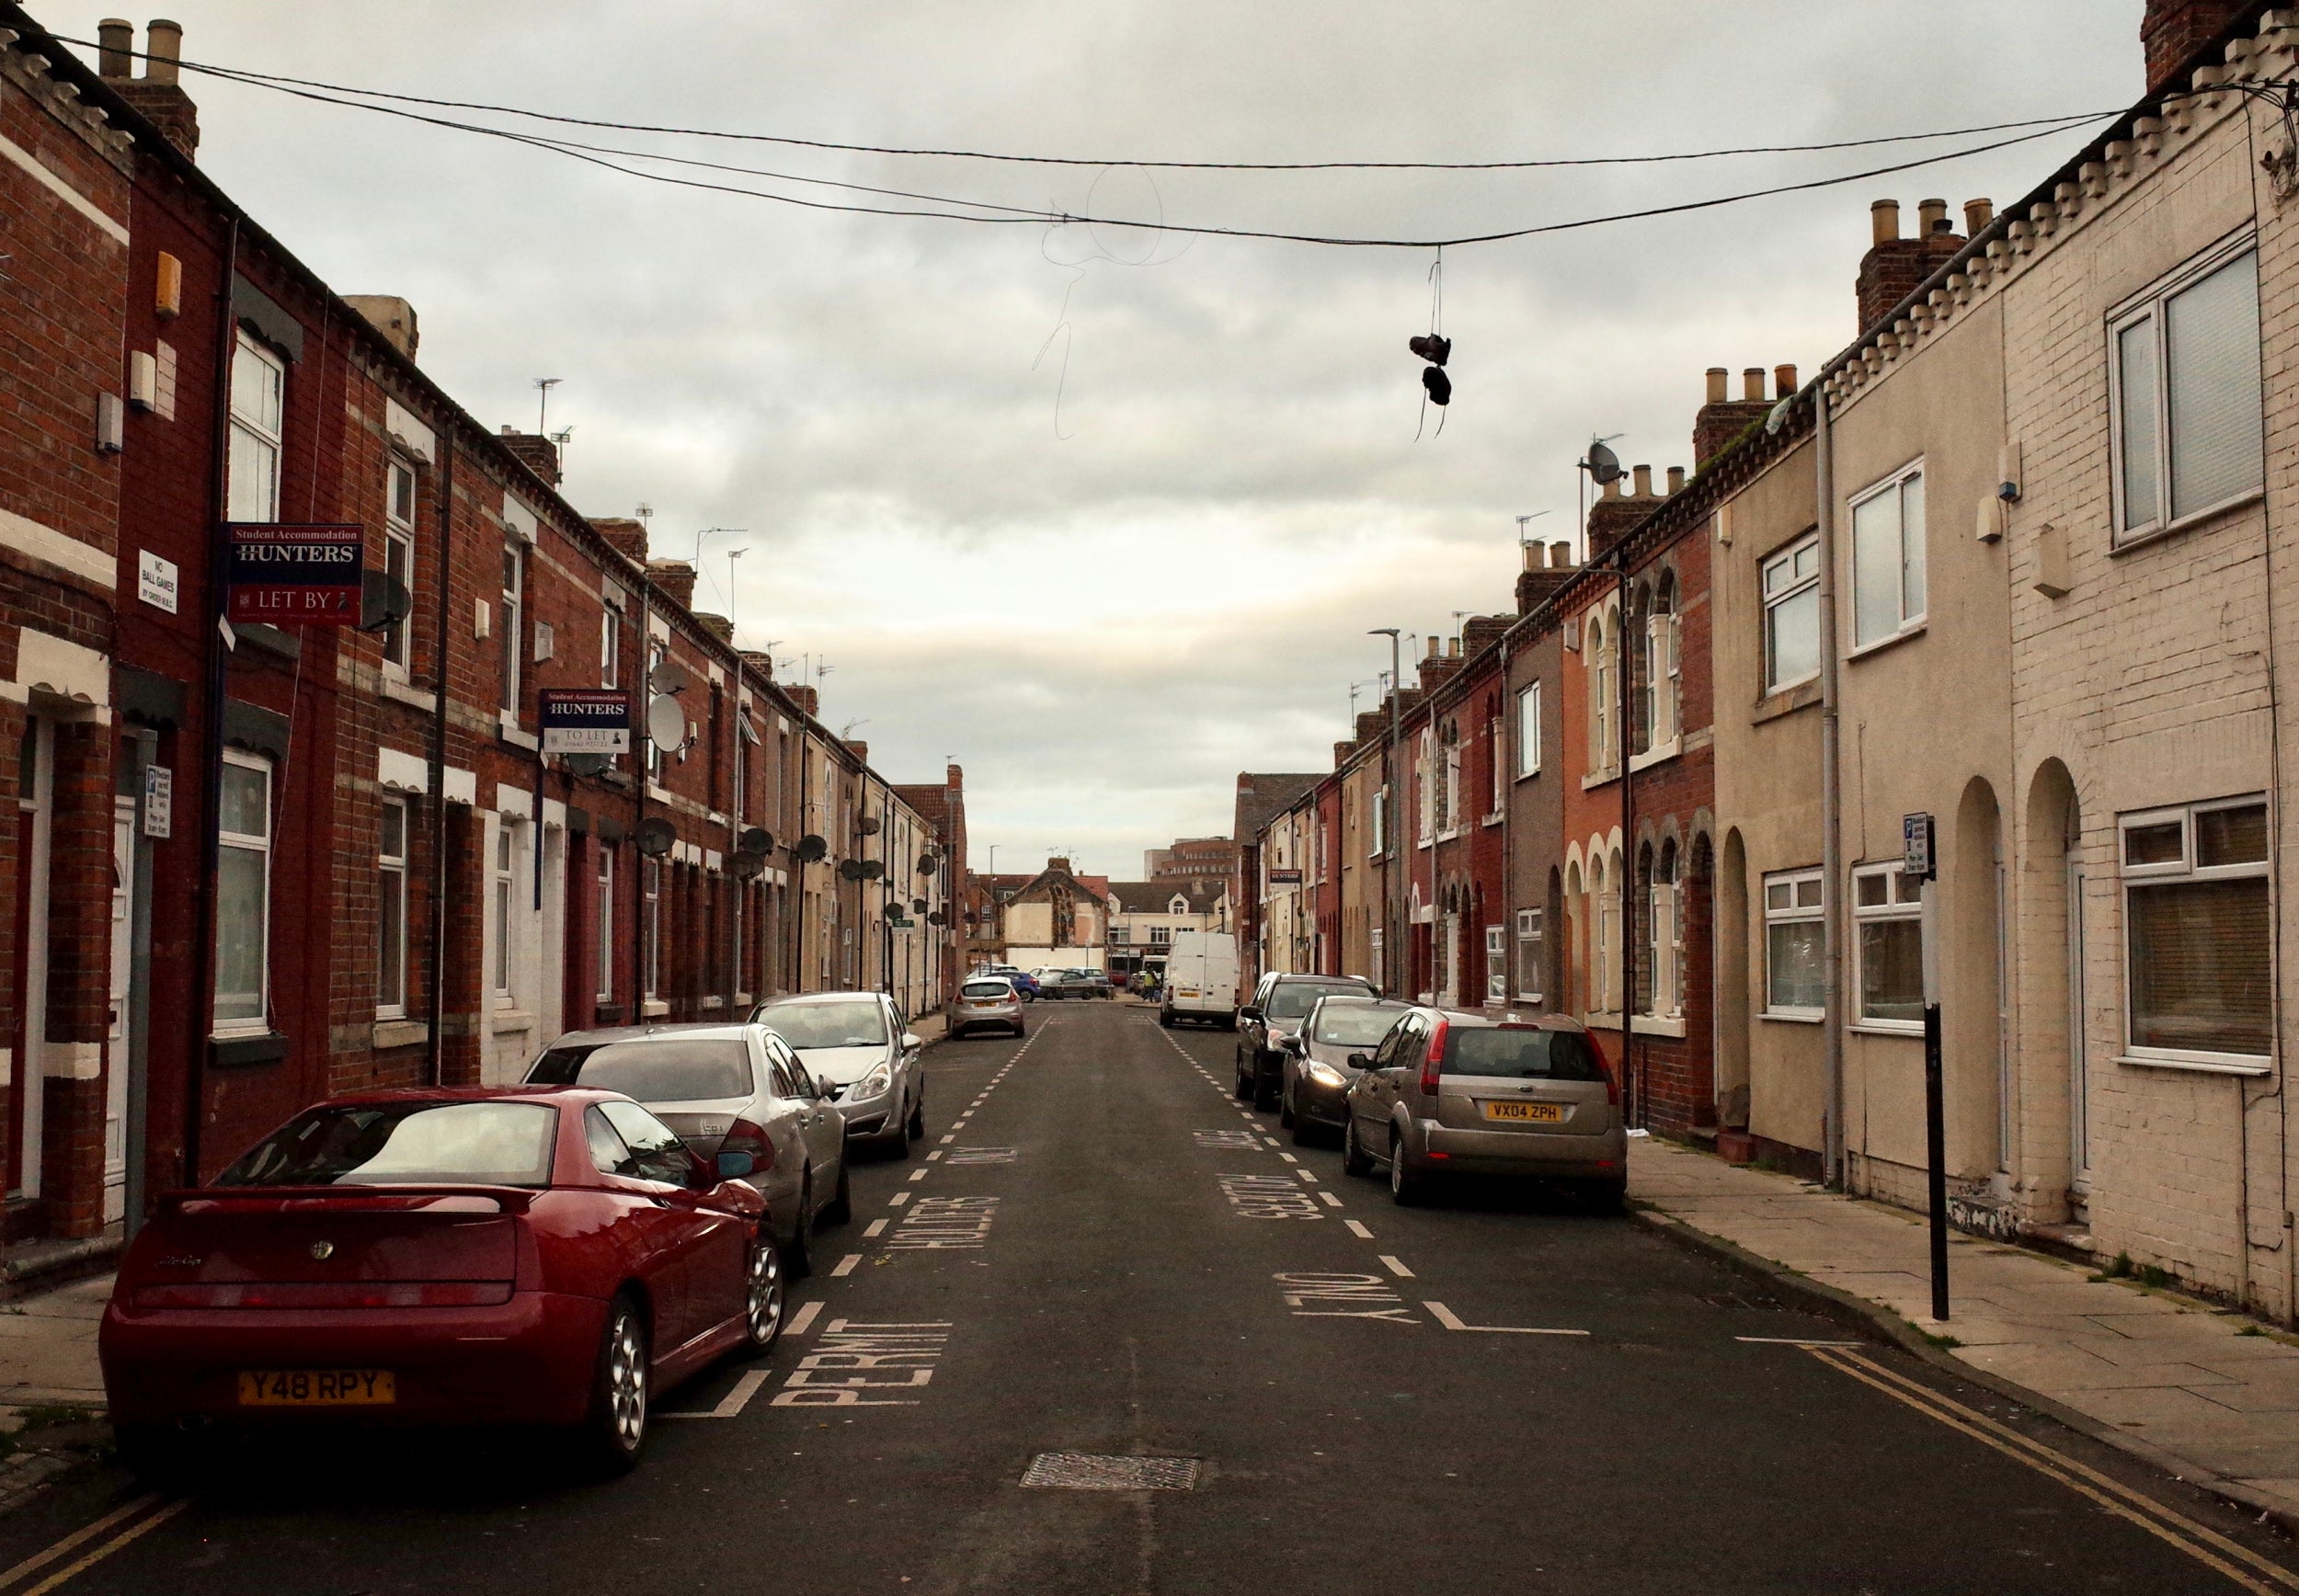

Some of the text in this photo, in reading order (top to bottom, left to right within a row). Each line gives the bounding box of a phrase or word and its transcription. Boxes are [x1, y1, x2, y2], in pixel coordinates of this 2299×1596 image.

[236, 530, 357, 540] Student Accommodation
[236, 544, 355, 563] HUNTERS
[154, 559, 164, 574] NO
[142, 569, 175, 594] BALL GAMES
[258, 591, 331, 609] LET BY
[575, 693, 626, 701] Accommodation
[550, 703, 625, 715] HUNTERS
[565, 730, 609, 740] TO LET
[149, 770, 154, 791] P
[1493, 1104, 1557, 1119] VX04 ZPH
[1214, 1173, 1325, 1219] HOLDERS
[884, 1196, 1001, 1249] HOLDERS
[1272, 1272, 1423, 1325] ONLY
[770, 1318, 954, 1407] PERMIT
[252, 1372, 378, 1399] Y48 RPY
